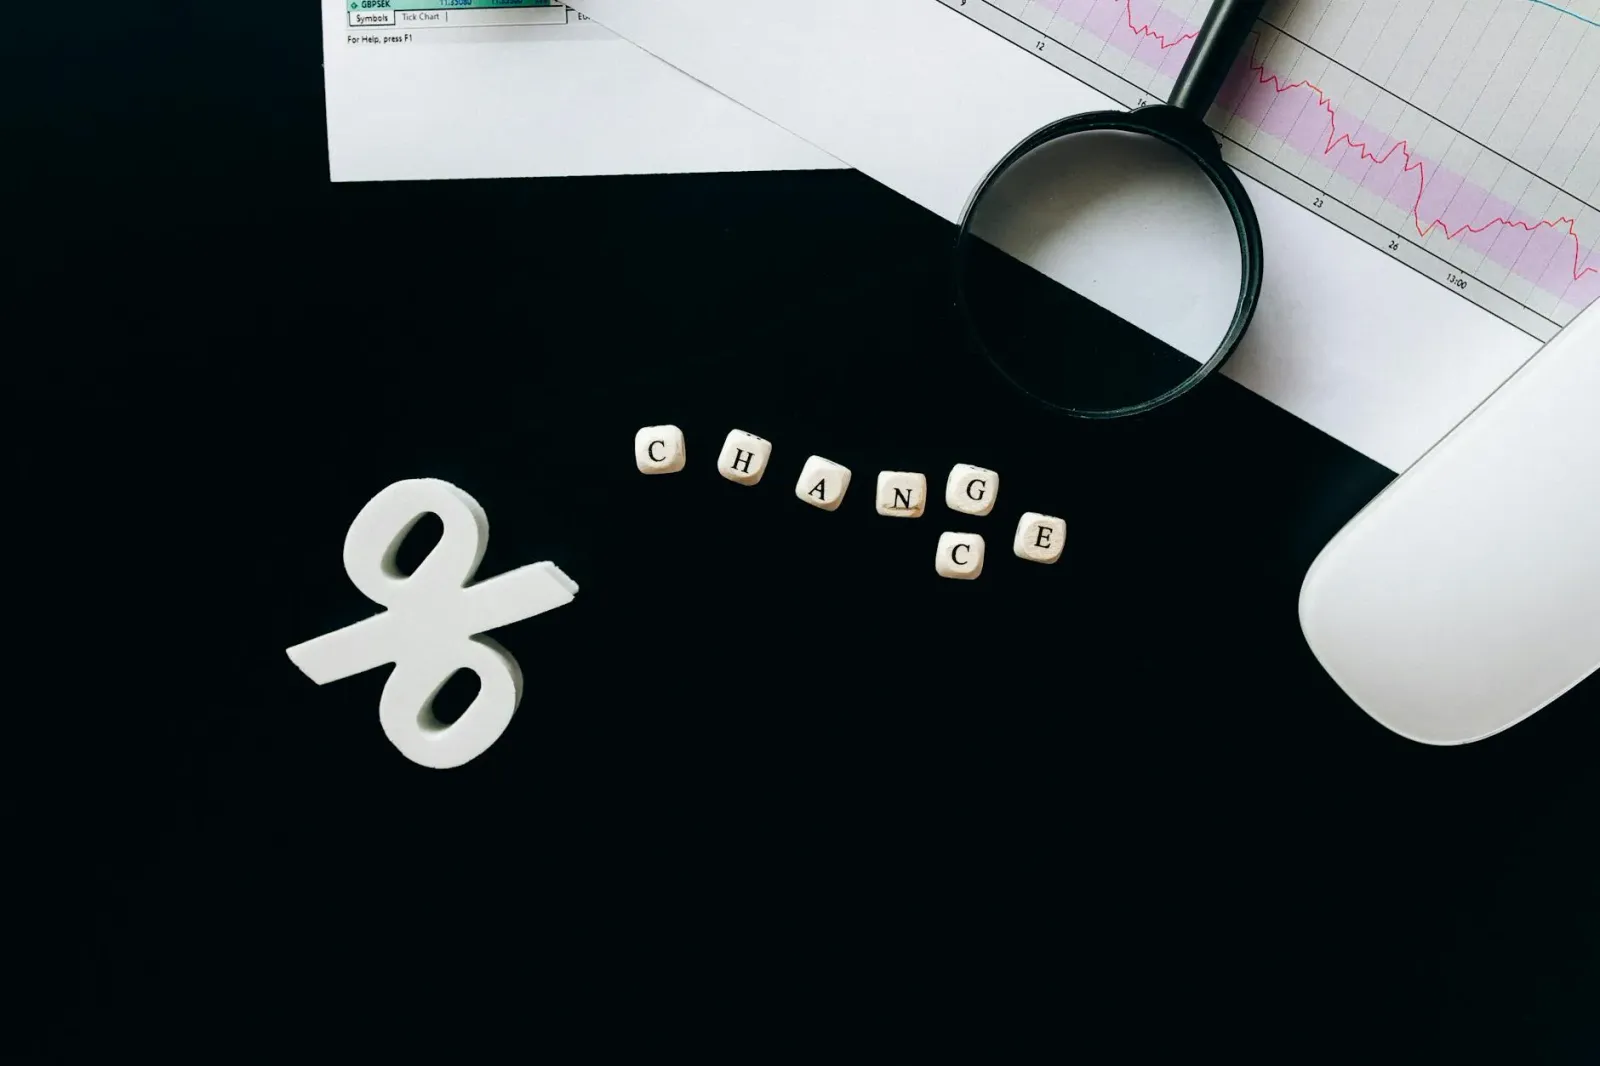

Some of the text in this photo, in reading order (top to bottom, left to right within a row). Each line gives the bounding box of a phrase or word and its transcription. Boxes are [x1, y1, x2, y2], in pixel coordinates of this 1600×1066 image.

[361, 0, 391, 8] GBPSEK
[356, 12, 440, 24] Symbols Tick Chart
[347, 34, 413, 44] For Help, press F1
[1035, 41, 1046, 51] 12
[1313, 197, 1324, 208] 23
[1388, 240, 1399, 251] 26
[1445, 273, 1468, 290] 13:00
